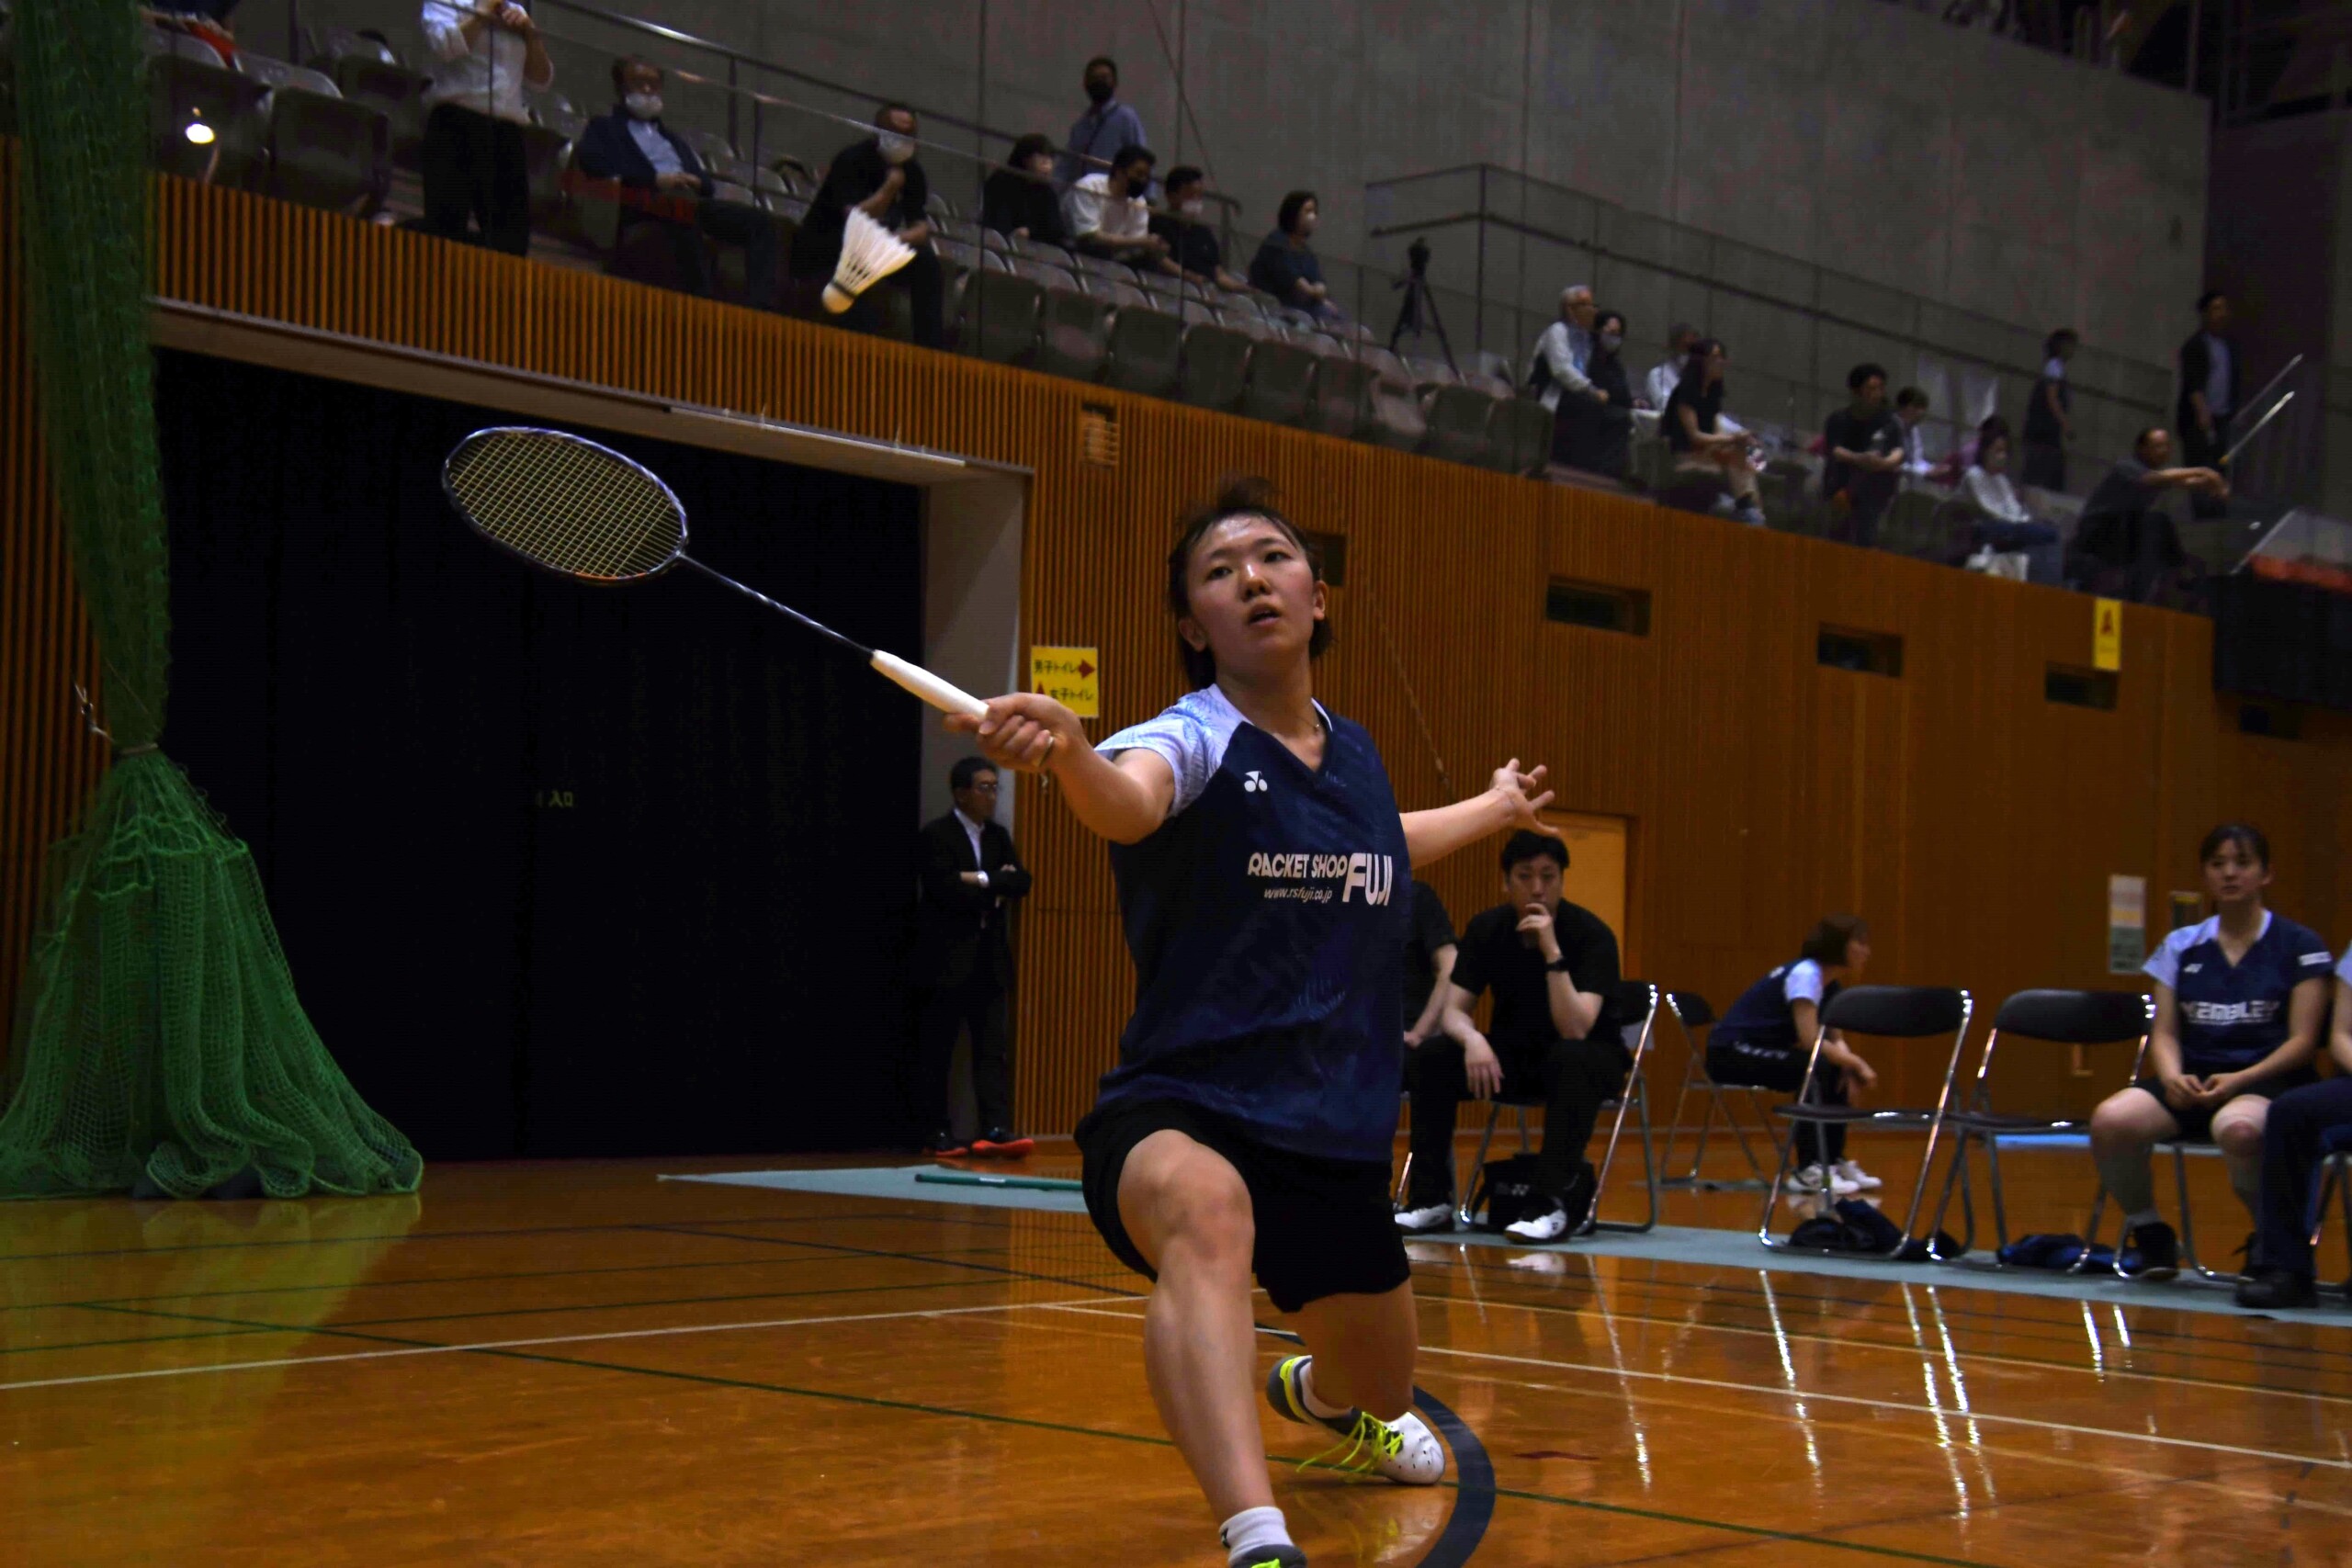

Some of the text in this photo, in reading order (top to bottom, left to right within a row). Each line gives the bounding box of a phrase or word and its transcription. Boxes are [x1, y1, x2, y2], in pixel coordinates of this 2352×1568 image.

[1035, 660, 1078, 673] 男子トイレ
[1247, 852, 1392, 906] RACKET SHOP FUJI
[1263, 886, 1332, 904] www.rsfuji.co.jp
